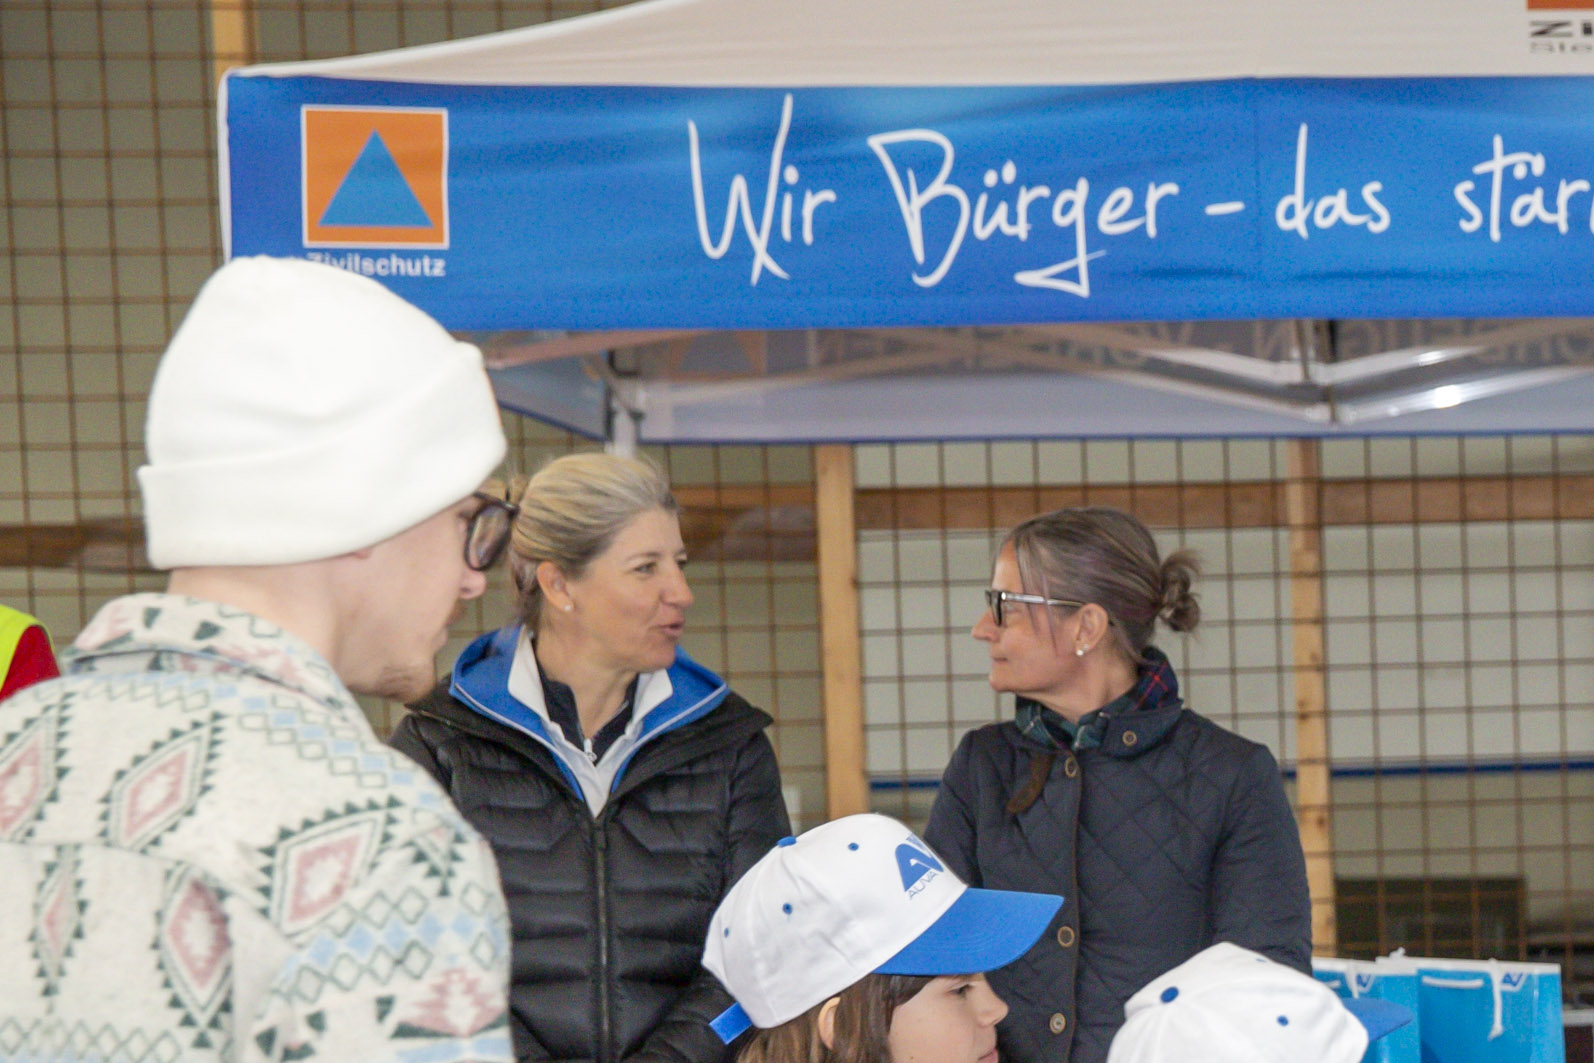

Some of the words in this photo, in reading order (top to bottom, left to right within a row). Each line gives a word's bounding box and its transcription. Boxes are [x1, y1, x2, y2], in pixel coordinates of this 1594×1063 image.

[688, 94, 837, 287] Wir
[867, 129, 1181, 299] Bürger
[1275, 123, 1392, 241] das
[909, 871, 938, 900] AUVA
